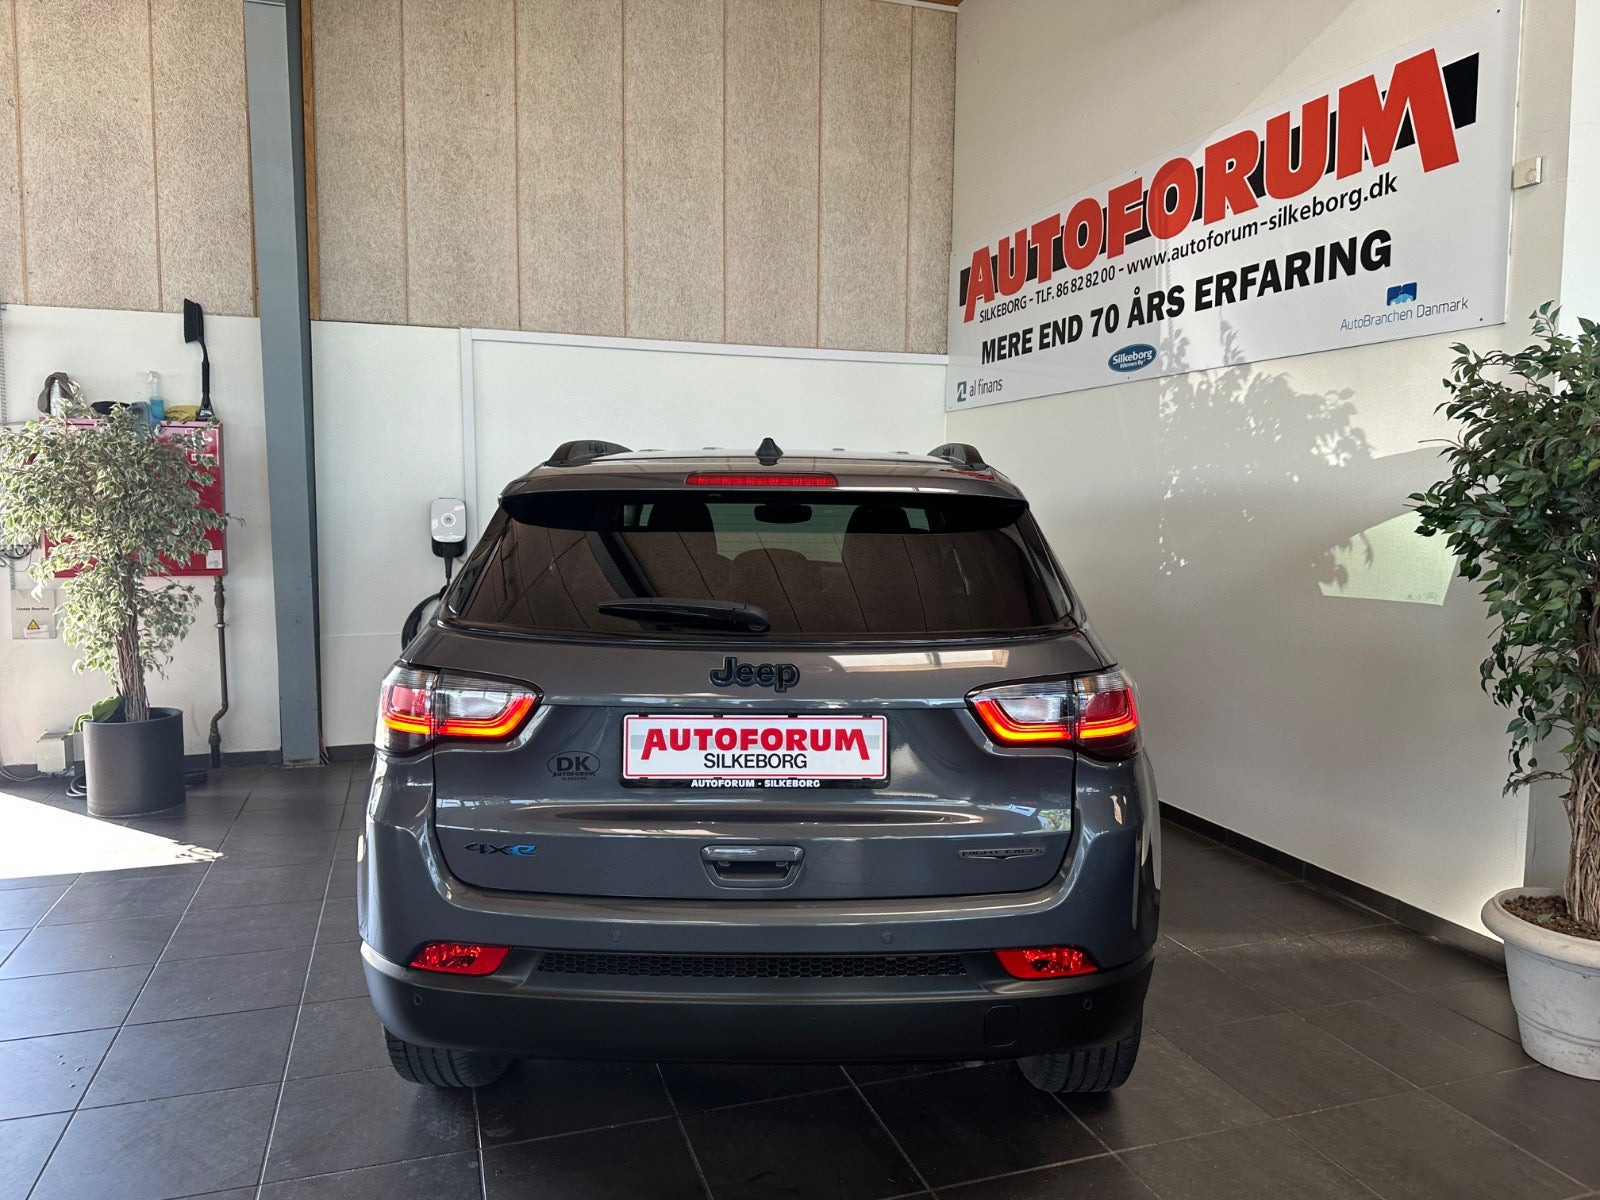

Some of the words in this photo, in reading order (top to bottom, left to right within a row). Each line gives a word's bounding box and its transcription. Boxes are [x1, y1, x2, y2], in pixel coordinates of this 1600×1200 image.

[963, 47, 1460, 324] AUTOFORUM
[979, 295, 1027, 323] SILKEBORG
[1035, 287, 1055, 305] TLF.
[1126, 172, 1398, 275] www.autoforum-silkeborg.dk
[981, 327, 1033, 365] MERE
[1039, 314, 1083, 350] END
[1090, 303, 1120, 337] 70
[1126, 286, 1185, 328] ÅRS
[1194, 229, 1392, 312] ERFARING
[1340, 308, 1413, 332] AutoBranchen
[1416, 297, 1469, 319] Danmark
[1112, 350, 1153, 365] Silkeborg
[969, 383, 976, 397] al
[977, 378, 1003, 396] finans
[709, 656, 800, 693] Jeep
[640, 727, 870, 760] AUTOFORUM
[556, 756, 590, 772] DK
[703, 753, 807, 769] SILKEBORG
[691, 779, 755, 788] AUTOFORUM
[764, 779, 820, 788] SILKEBORG
